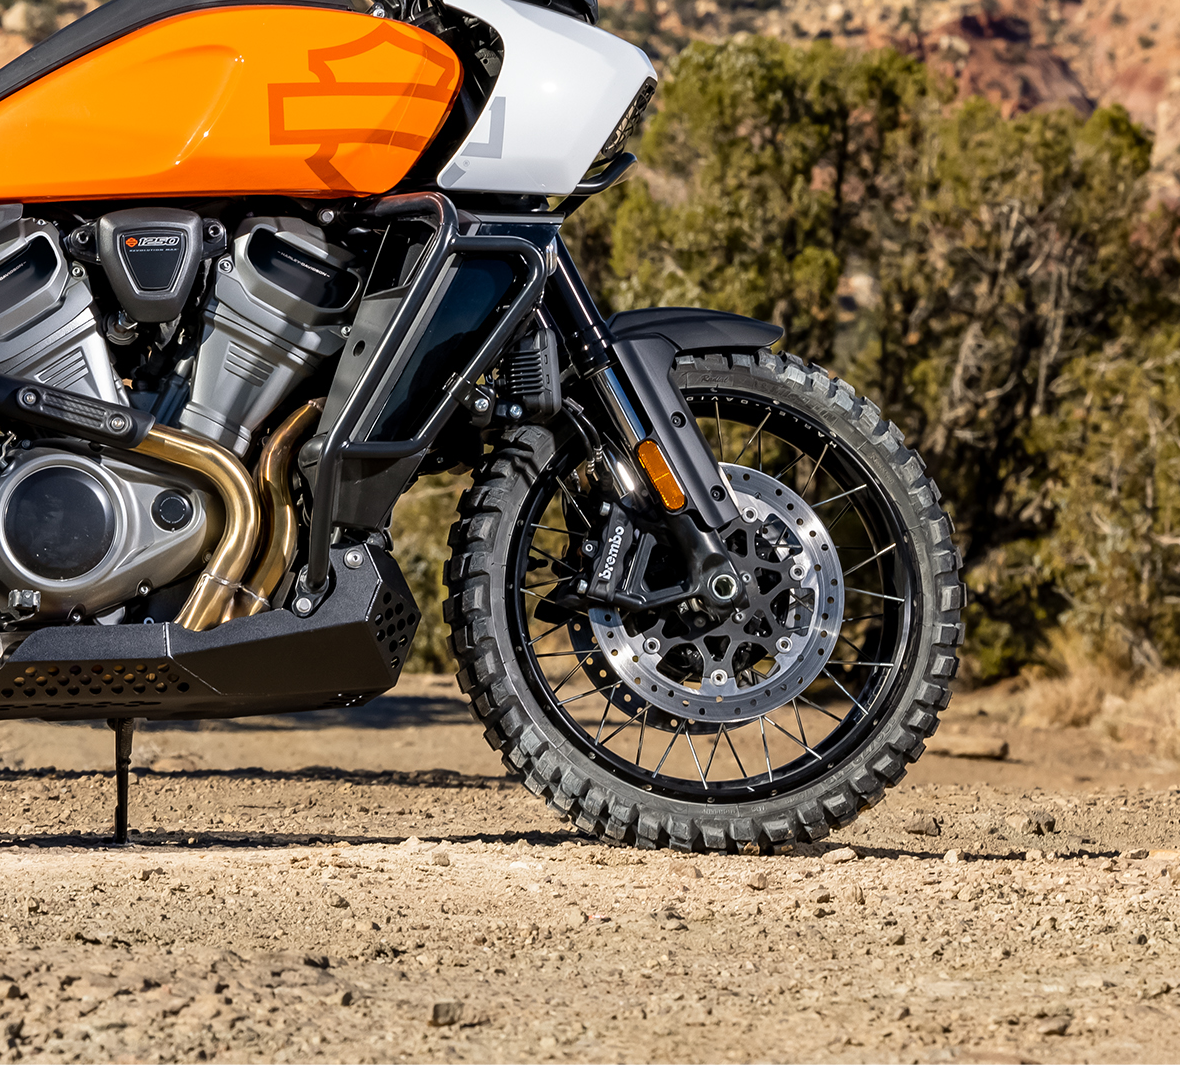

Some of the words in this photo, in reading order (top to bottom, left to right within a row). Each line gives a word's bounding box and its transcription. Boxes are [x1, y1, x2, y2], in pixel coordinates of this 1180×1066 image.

[138, 236, 180, 247] 1250
[686, 395, 838, 449] HARLEY-DAVID
[598, 526, 625, 580] brembo
